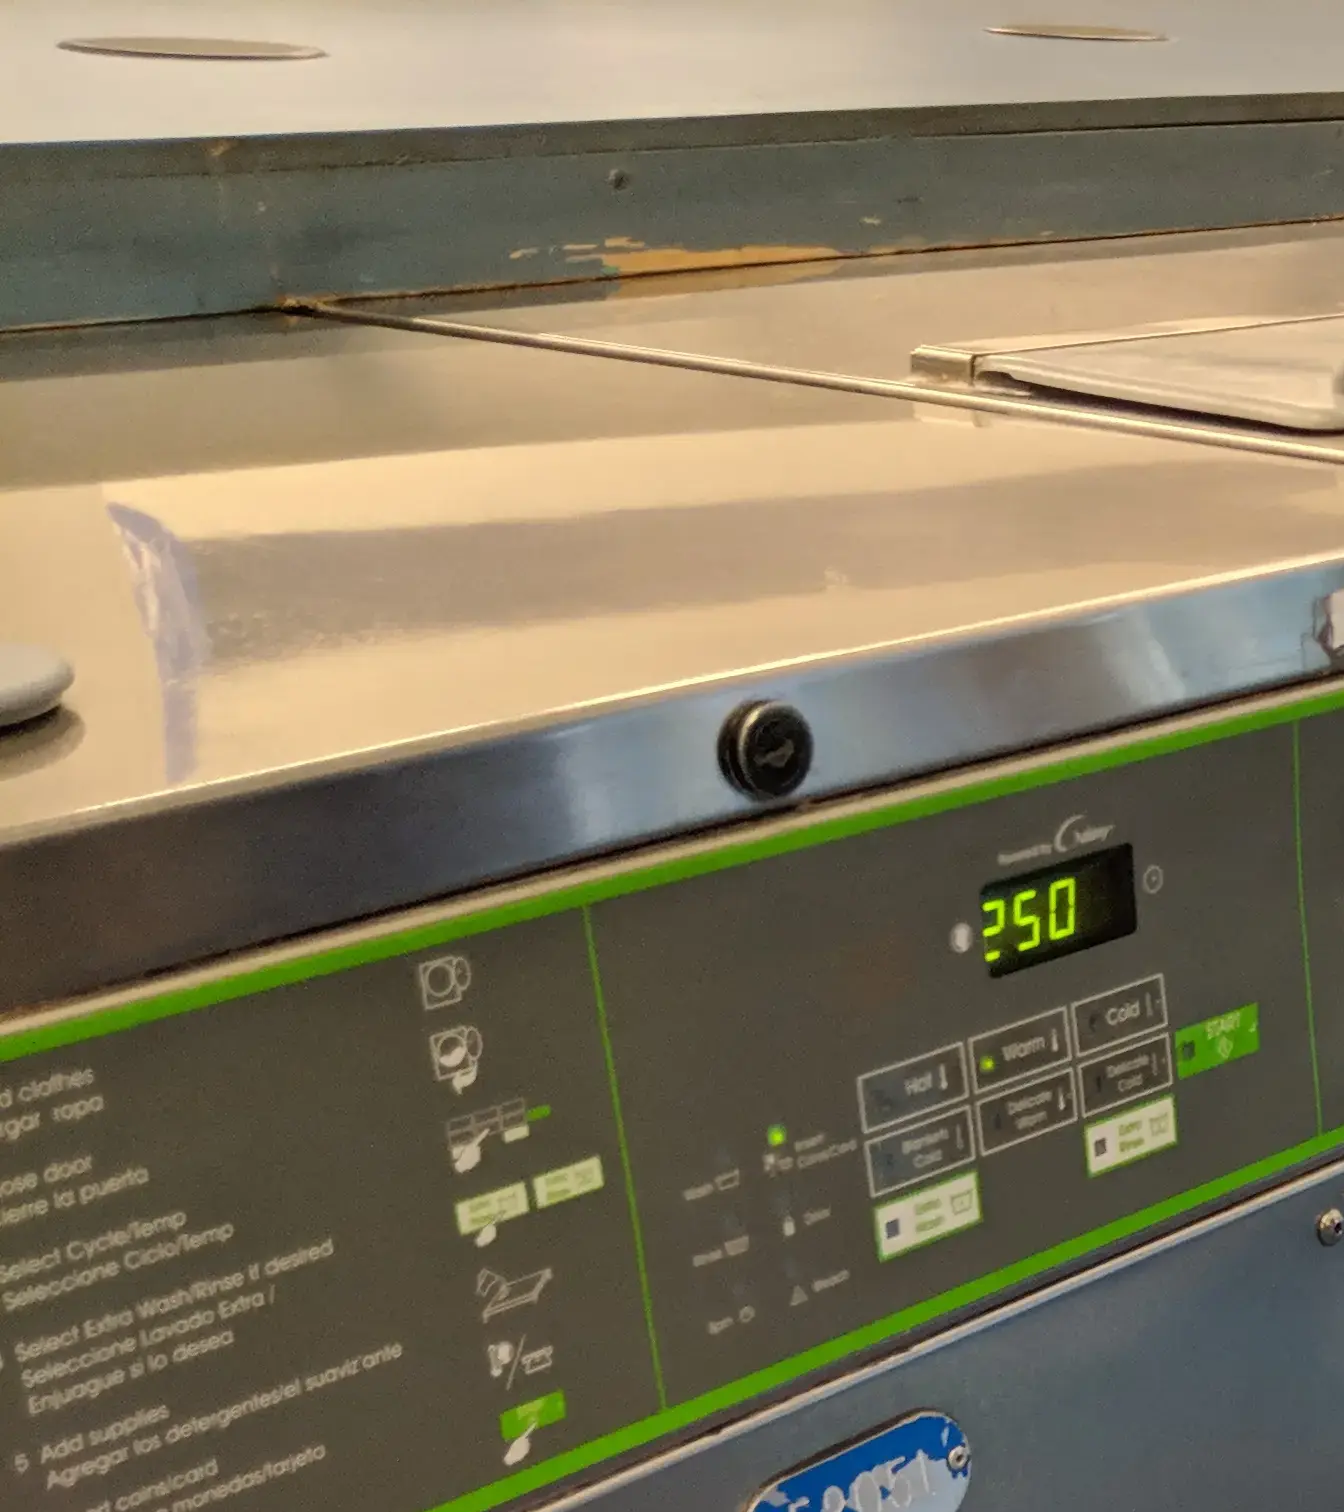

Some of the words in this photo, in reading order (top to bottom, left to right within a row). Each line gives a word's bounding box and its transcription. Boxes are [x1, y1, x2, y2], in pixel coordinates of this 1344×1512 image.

[1106, 1002, 1141, 1026] Cold
[1003, 1036, 1046, 1061] Warm
[53, 1096, 103, 1122] ropa
[44, 1156, 92, 1183] door
[79, 1168, 149, 1204] puerta
[2, 1261, 120, 1312] Seleccione
[14, 1325, 80, 1362] Select
[83, 1310, 134, 1340] Extra
[136, 1271, 244, 1320] Wash/Rinse
[264, 1238, 334, 1276] desired
[21, 1337, 137, 1389] Seleccione
[139, 1310, 215, 1348] Lavado
[218, 1292, 265, 1320] Extra
[28, 1368, 126, 1417] Enjuague
[129, 1357, 145, 1379] si
[147, 1353, 168, 1372] lo
[172, 1330, 234, 1363] desea
[14, 1454, 29, 1474] 5
[40, 1438, 85, 1464] Add
[88, 1404, 170, 1446] supplies
[46, 1446, 129, 1491] Agregar
[133, 1435, 163, 1456] los
[165, 1377, 301, 1445] detergentes/el
[114, 1458, 219, 1512] coins/card
